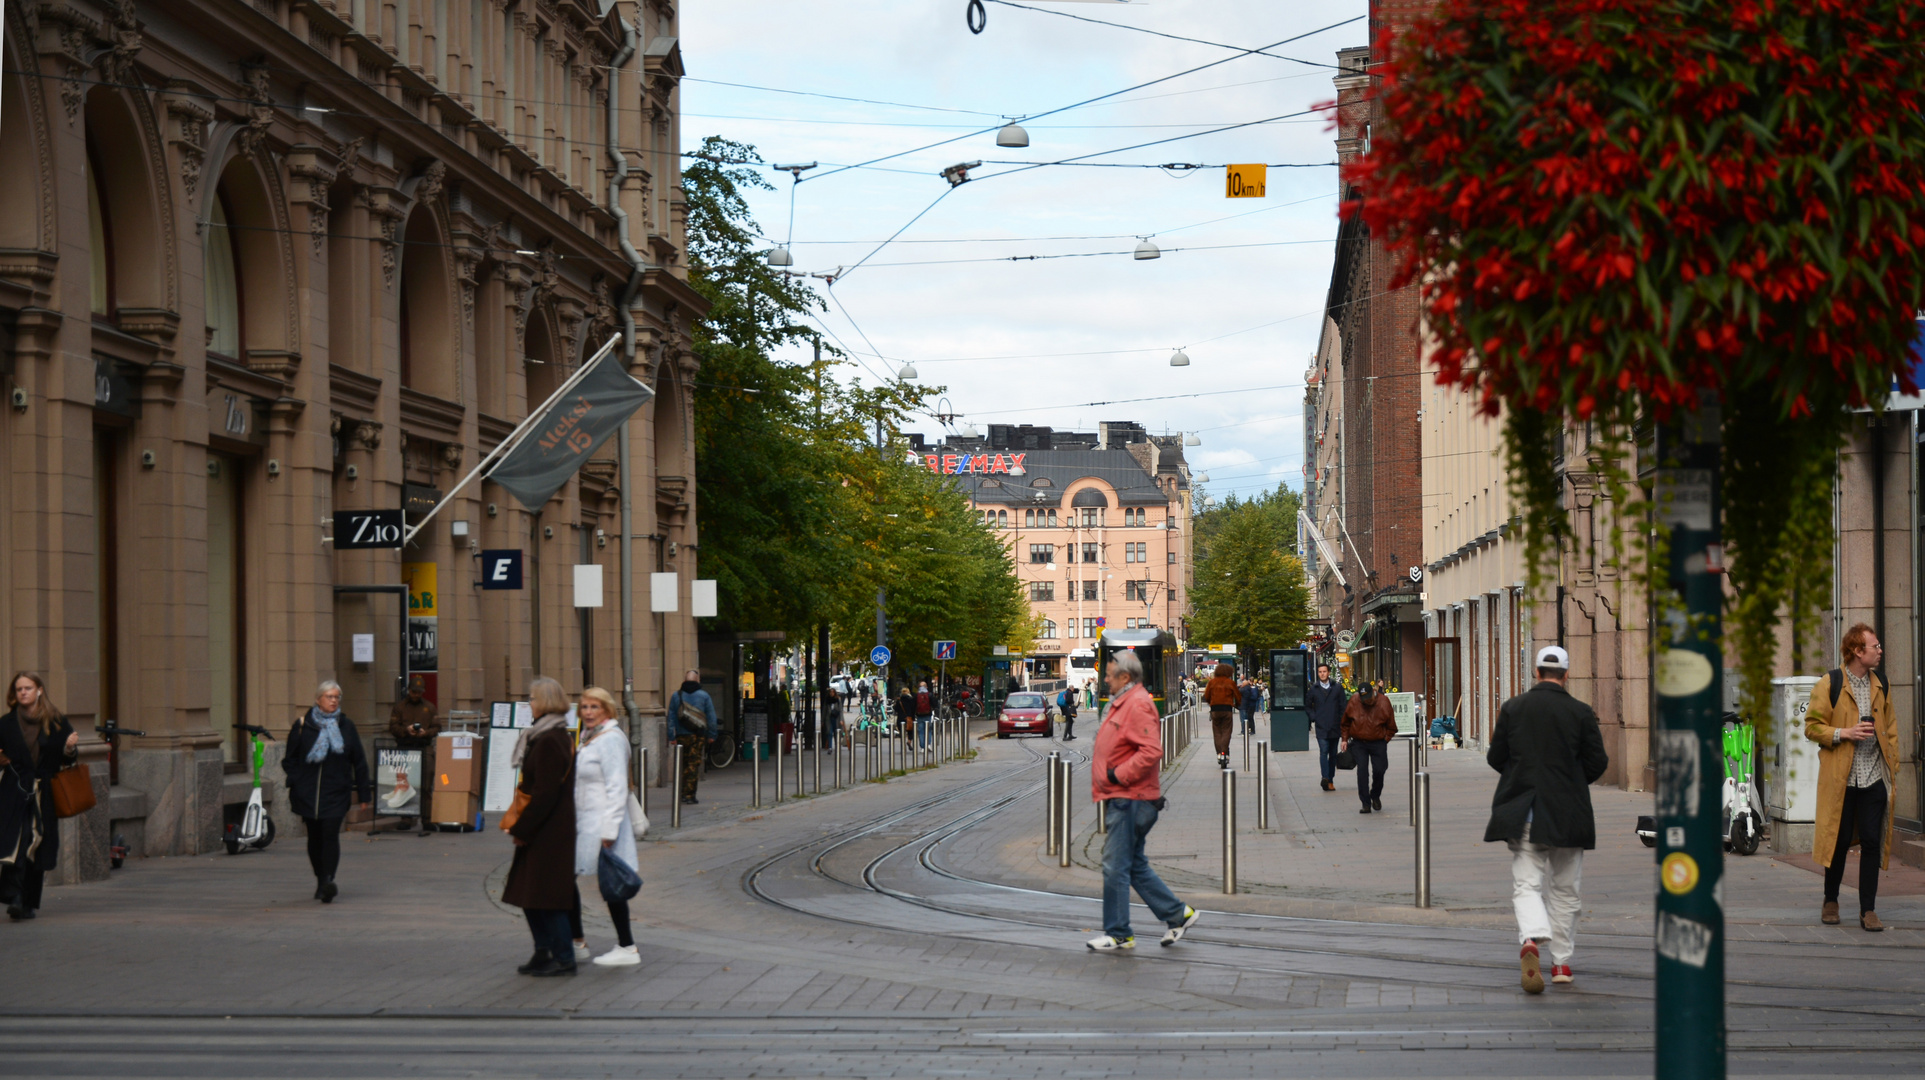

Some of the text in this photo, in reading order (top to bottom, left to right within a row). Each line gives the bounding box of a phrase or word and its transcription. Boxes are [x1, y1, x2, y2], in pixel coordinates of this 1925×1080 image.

[537, 395, 594, 457] Aleksi
[566, 427, 593, 455] 15
[925, 453, 1026, 474] RE/MAX
[351, 515, 400, 543] Zio
[492, 558, 512, 581] E
